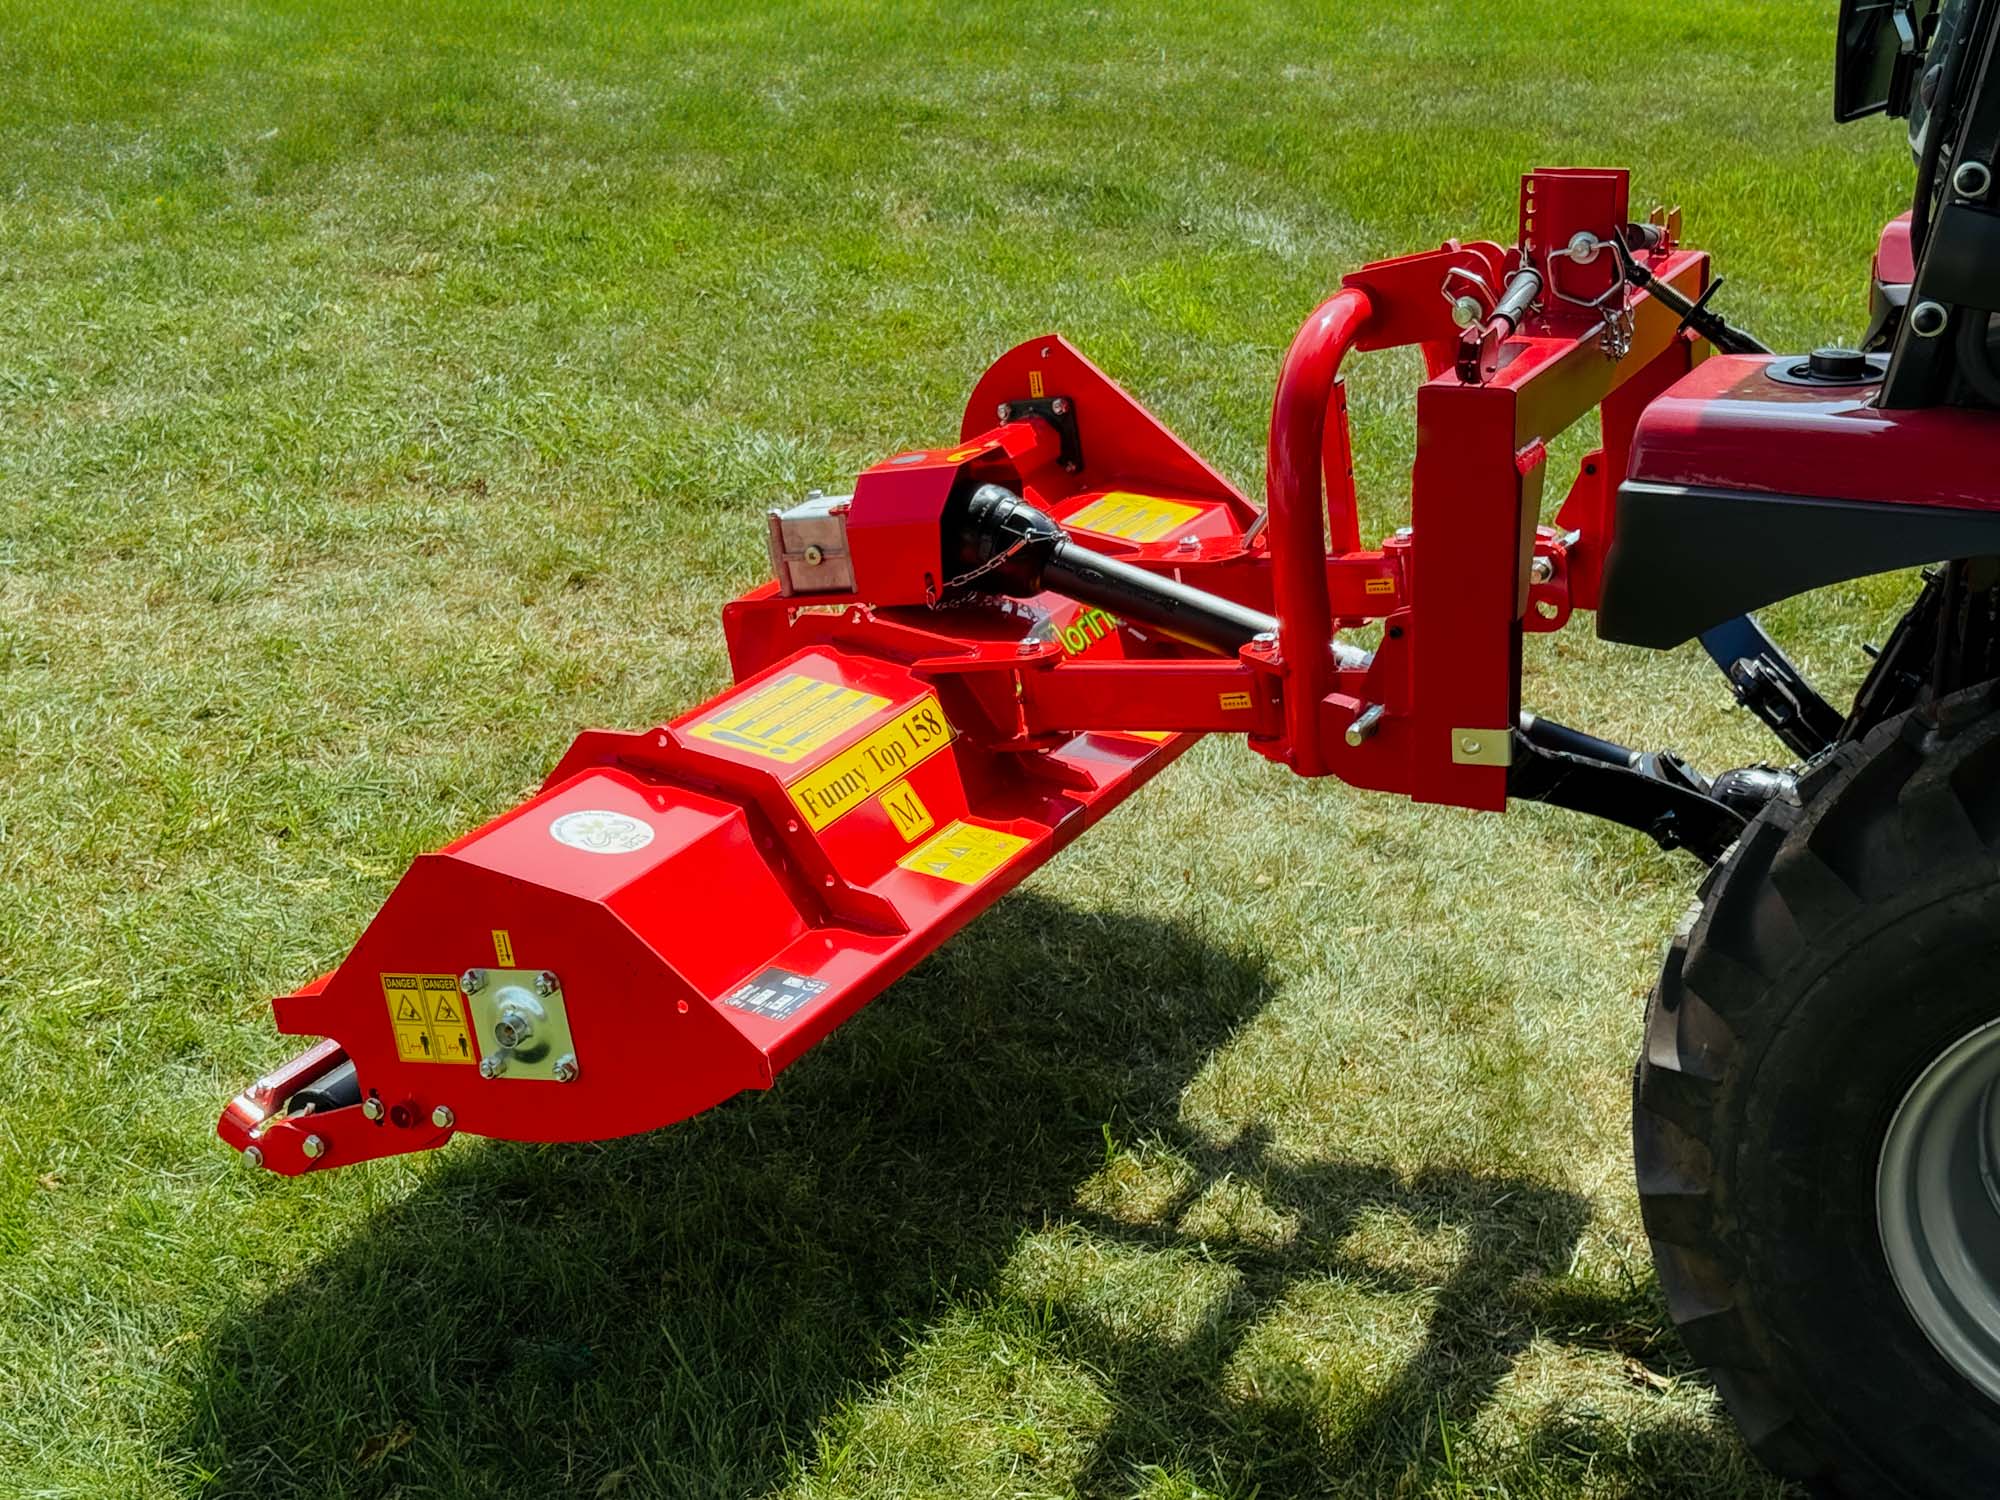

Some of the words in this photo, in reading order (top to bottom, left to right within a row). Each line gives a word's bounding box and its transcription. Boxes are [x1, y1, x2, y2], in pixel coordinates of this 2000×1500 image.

[798, 764, 870, 819] Funny
[863, 740, 906, 773] Top
[902, 708, 942, 748] 158
[890, 793, 924, 831] M
[386, 978, 418, 989] DANGER
[423, 979, 456, 989] DANGER
